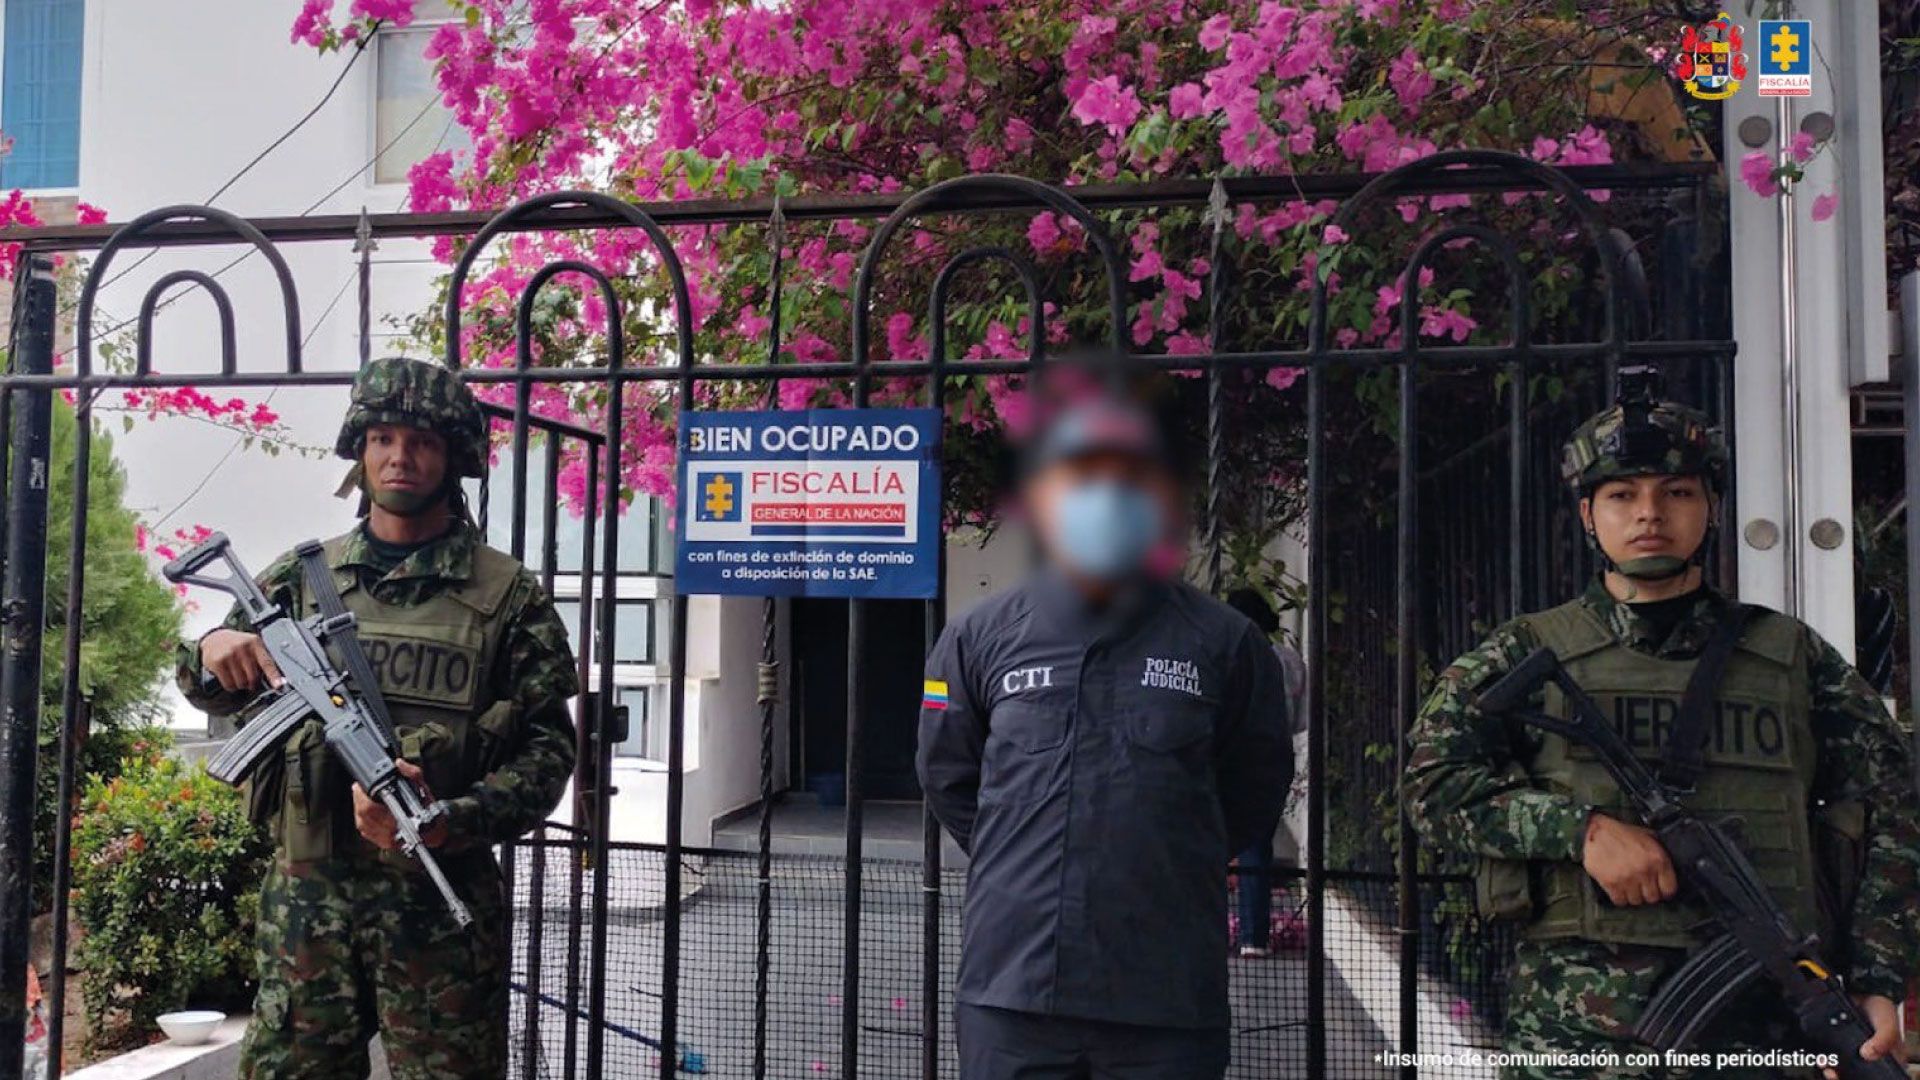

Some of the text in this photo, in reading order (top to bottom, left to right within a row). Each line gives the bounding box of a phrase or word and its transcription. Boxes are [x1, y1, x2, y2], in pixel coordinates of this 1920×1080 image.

[689, 425, 920, 452] BIEN OCUPADO
[752, 465, 905, 494] FISCALÍA
[755, 504, 901, 520] GENERAL DE LA NACIÓN
[688, 550, 915, 564] con fines de extinción de dominio
[721, 567, 878, 581] a disposición de la SAE.
[361, 640, 470, 694] RCITO
[1003, 666, 1054, 693] CTI
[1145, 657, 1199, 680] POLICÍA
[1141, 671, 1203, 696] JUDICIAL
